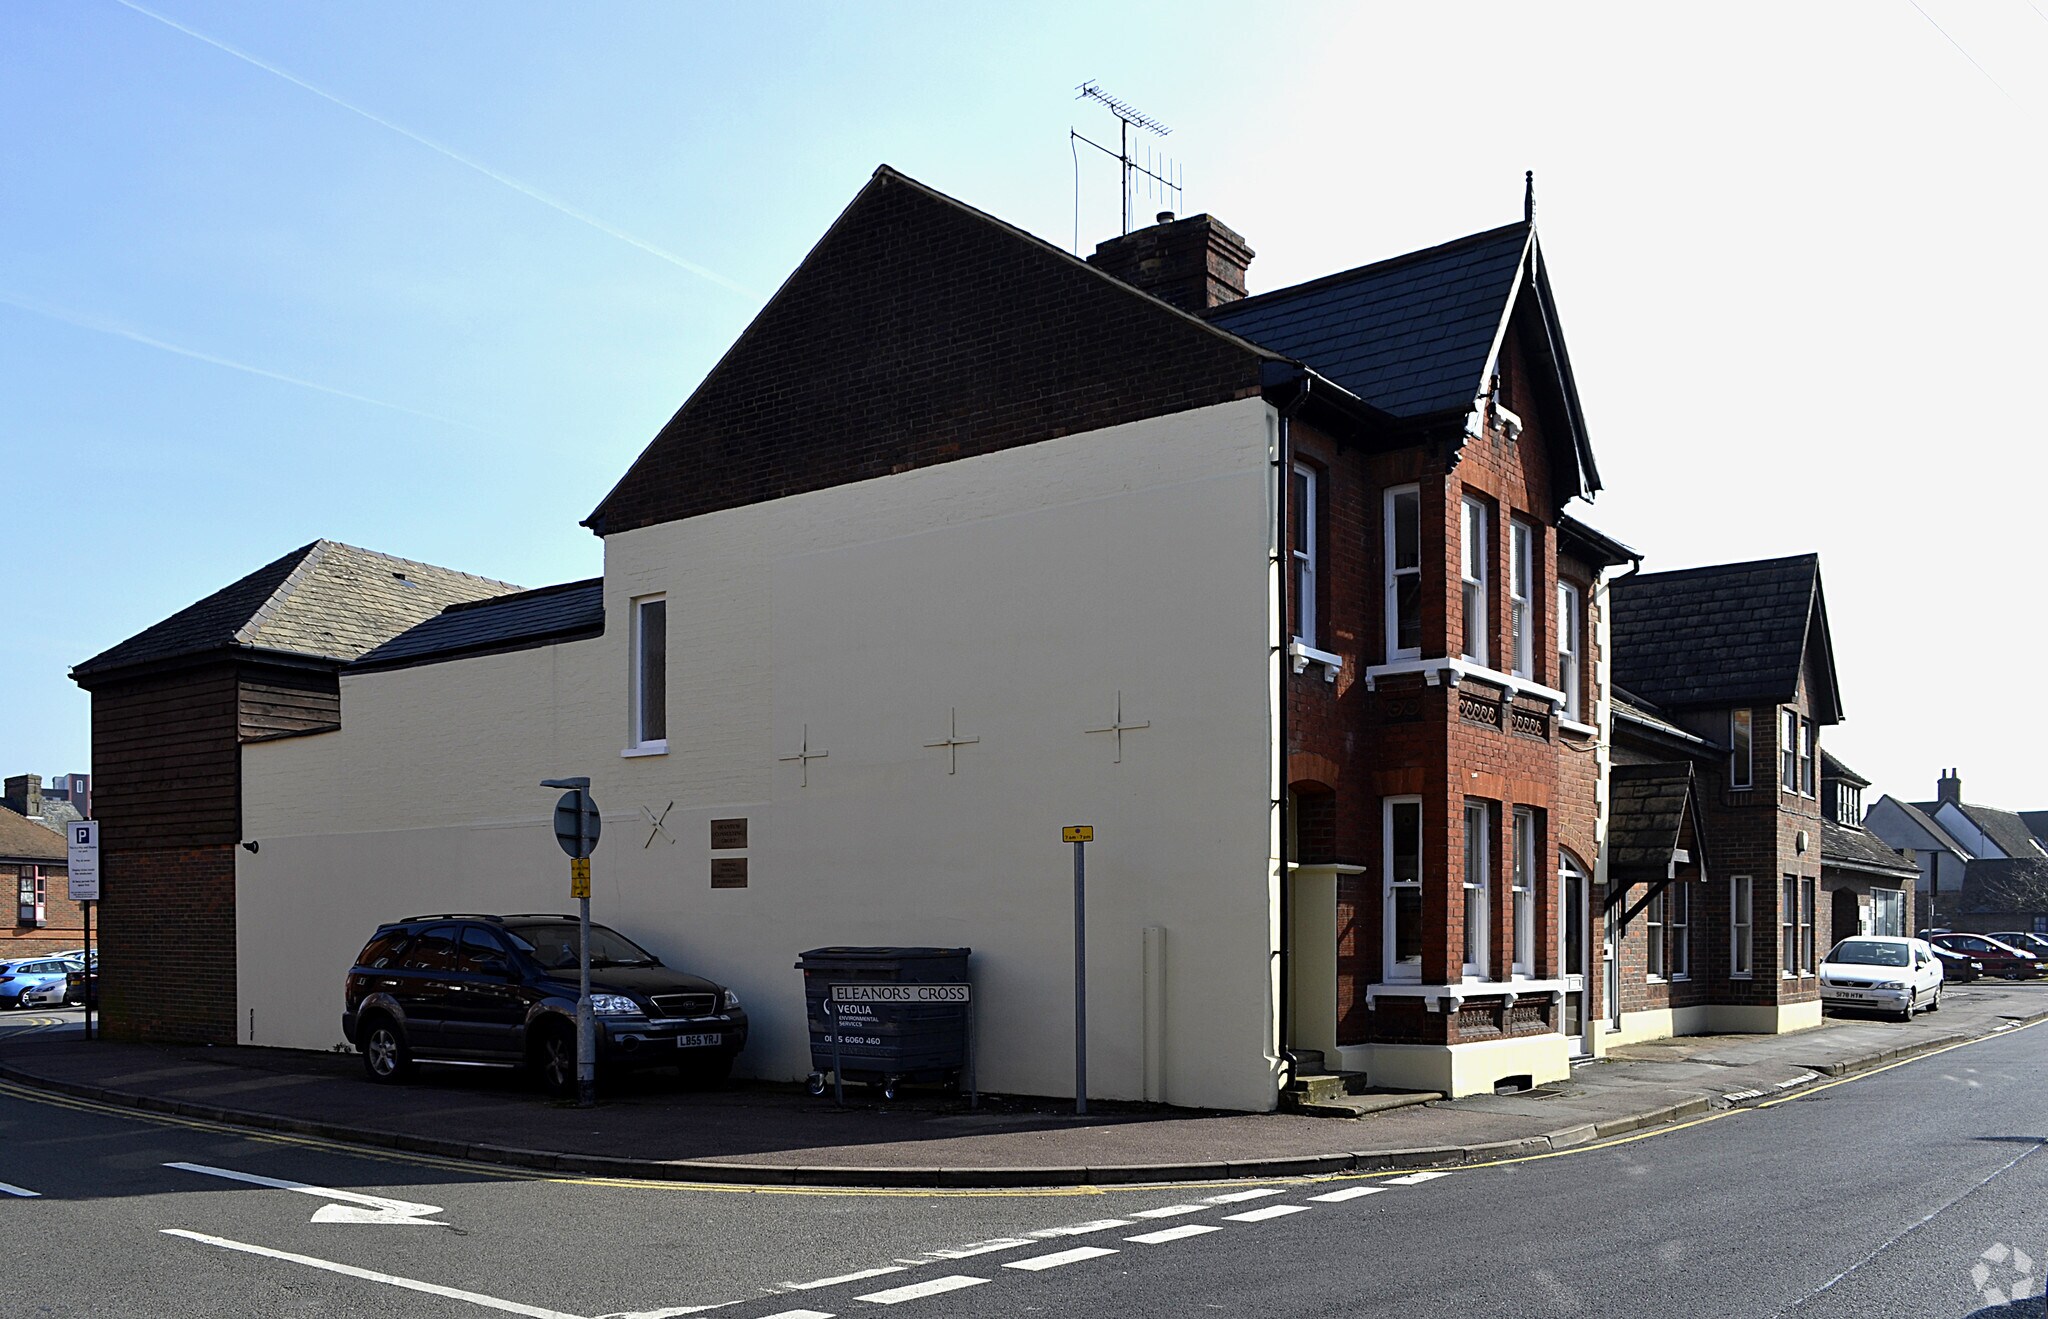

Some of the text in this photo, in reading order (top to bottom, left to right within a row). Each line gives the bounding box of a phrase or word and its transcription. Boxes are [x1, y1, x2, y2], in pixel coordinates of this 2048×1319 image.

[79, 829, 87, 843] P
[836, 987, 965, 1000] ELEANORS CROSS
[837, 1004, 872, 1015] VEOLIA
[838, 1015, 879, 1023] ENVIRONMENTAL
[680, 1034, 719, 1046] LB55 YRJ
[844, 1036, 864, 1045] 6060
[865, 1037, 881, 1045] 460
